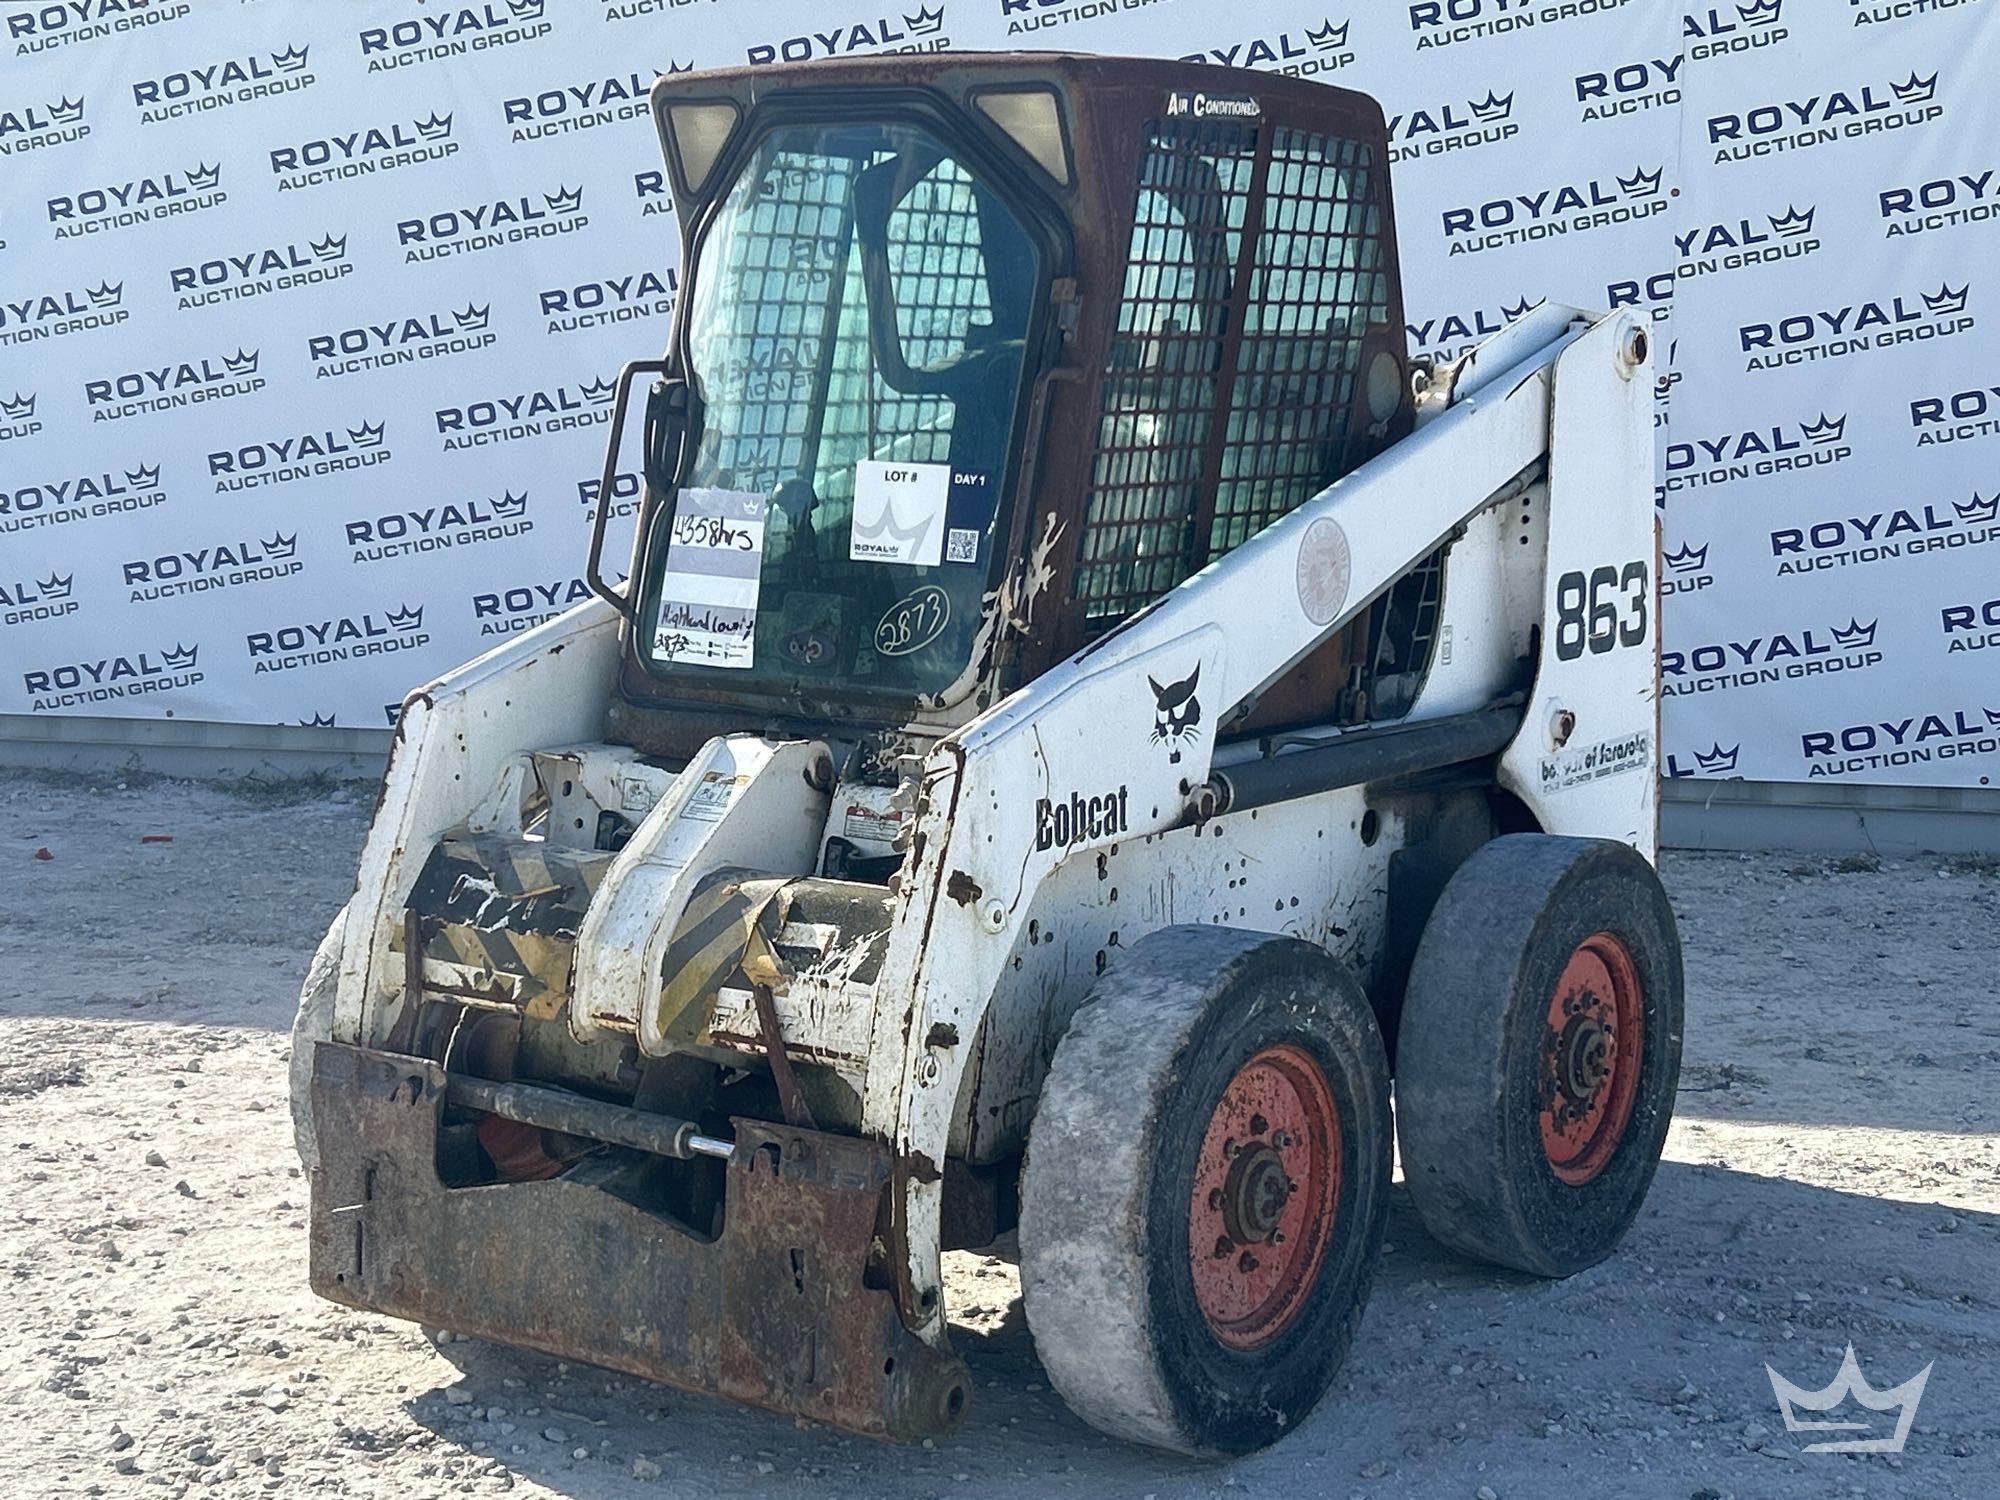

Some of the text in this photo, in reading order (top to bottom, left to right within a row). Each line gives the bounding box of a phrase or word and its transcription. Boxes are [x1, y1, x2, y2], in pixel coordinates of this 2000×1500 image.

[16, 5, 190, 56] AUCTION GROUP
[360, 5, 508, 55] ROYAL
[1008, 0, 1117, 36] AUCTION
[1416, 13, 1534, 51] AUCTION
[368, 23, 552, 73] AUCTION GROUP
[1691, 28, 1788, 60] GROUP
[133, 57, 273, 106] ROYAL
[504, 74, 651, 124] ROYAL
[1575, 53, 1685, 102] ROY
[141, 74, 315, 125] AUCTION GROUP
[1582, 89, 1681, 123] AUCTIO
[1708, 87, 1890, 144] ROYAL
[16, 126, 90, 152] GROUP
[512, 110, 613, 143] AUCTION
[1386, 105, 1470, 143] YAL
[1426, 124, 1519, 155] GROUP
[1714, 106, 1943, 164] AUCTION GROUP
[270, 124, 416, 174] ROYAL
[279, 143, 459, 192] AUCTION GROUP
[47, 175, 187, 222] ROYAL
[1442, 181, 1617, 236] ROYAL
[1879, 170, 2000, 217] ROY
[55, 192, 227, 240] AUCTION GROUP
[397, 198, 545, 245] ROYAL
[1449, 200, 1667, 257] AUCTION GROUP
[405, 217, 588, 264] AUCTION GROUP
[1675, 220, 1768, 257] YAL
[1724, 239, 1820, 269] GROUP
[170, 245, 312, 292] ROYAL
[178, 264, 353, 310] AUCTION GROUP
[0, 292, 88, 328] YAL
[0, 310, 129, 345] TION GROUP
[548, 304, 650, 334] AUCTION
[1405, 311, 1501, 347] YAL
[1740, 297, 1922, 352] ROYAL
[309, 315, 454, 361] ROYAL
[317, 334, 496, 379] AUCTION GROUP
[1746, 317, 1974, 372] AUCTION GROUP
[85, 360, 224, 405] ROYAL
[94, 379, 265, 422] AUCTION GROUP
[0, 421, 42, 440] OUP
[436, 388, 581, 433] ROYAL
[444, 409, 614, 451] AUCTION GROU
[208, 432, 349, 476] ROYAL
[1666, 427, 1800, 471] OYAL
[1917, 420, 2000, 447] AUCTI
[216, 451, 391, 493] AUCTION GROUP
[884, 470, 917, 483] LOT #
[954, 474, 985, 486] DAY 1
[1666, 447, 1851, 492] CTION GROUP
[92, 493, 166, 516] GROUP
[345, 502, 491, 545] ROYAL
[354, 521, 533, 563] AUCTION GROUP
[855, 544, 888, 553] ROYAL
[1771, 506, 1953, 556] ROYAL
[123, 543, 262, 585] ROYAL
[1777, 544, 1900, 576] AUCTION
[130, 562, 303, 603] AUCTION GROUP
[473, 579, 594, 617] ROYA
[1662, 575, 1714, 595] OUP
[5, 602, 78, 624] GROUP
[880, 593, 941, 652] 2873
[1556, 561, 1648, 661] 863
[247, 615, 387, 656] ROYAL
[255, 634, 429, 674] AUCTION GROUP
[1661, 631, 1831, 678] ROYAL
[24, 654, 162, 694] ROYAL
[33, 673, 203, 711] AUCTION GROUP
[1660, 652, 1882, 698] AUCTION GROUP
[1802, 711, 1984, 758] ROYAL
[1809, 738, 2000, 777] AUCTION GRO
[1036, 785, 1128, 852] Bobcat
